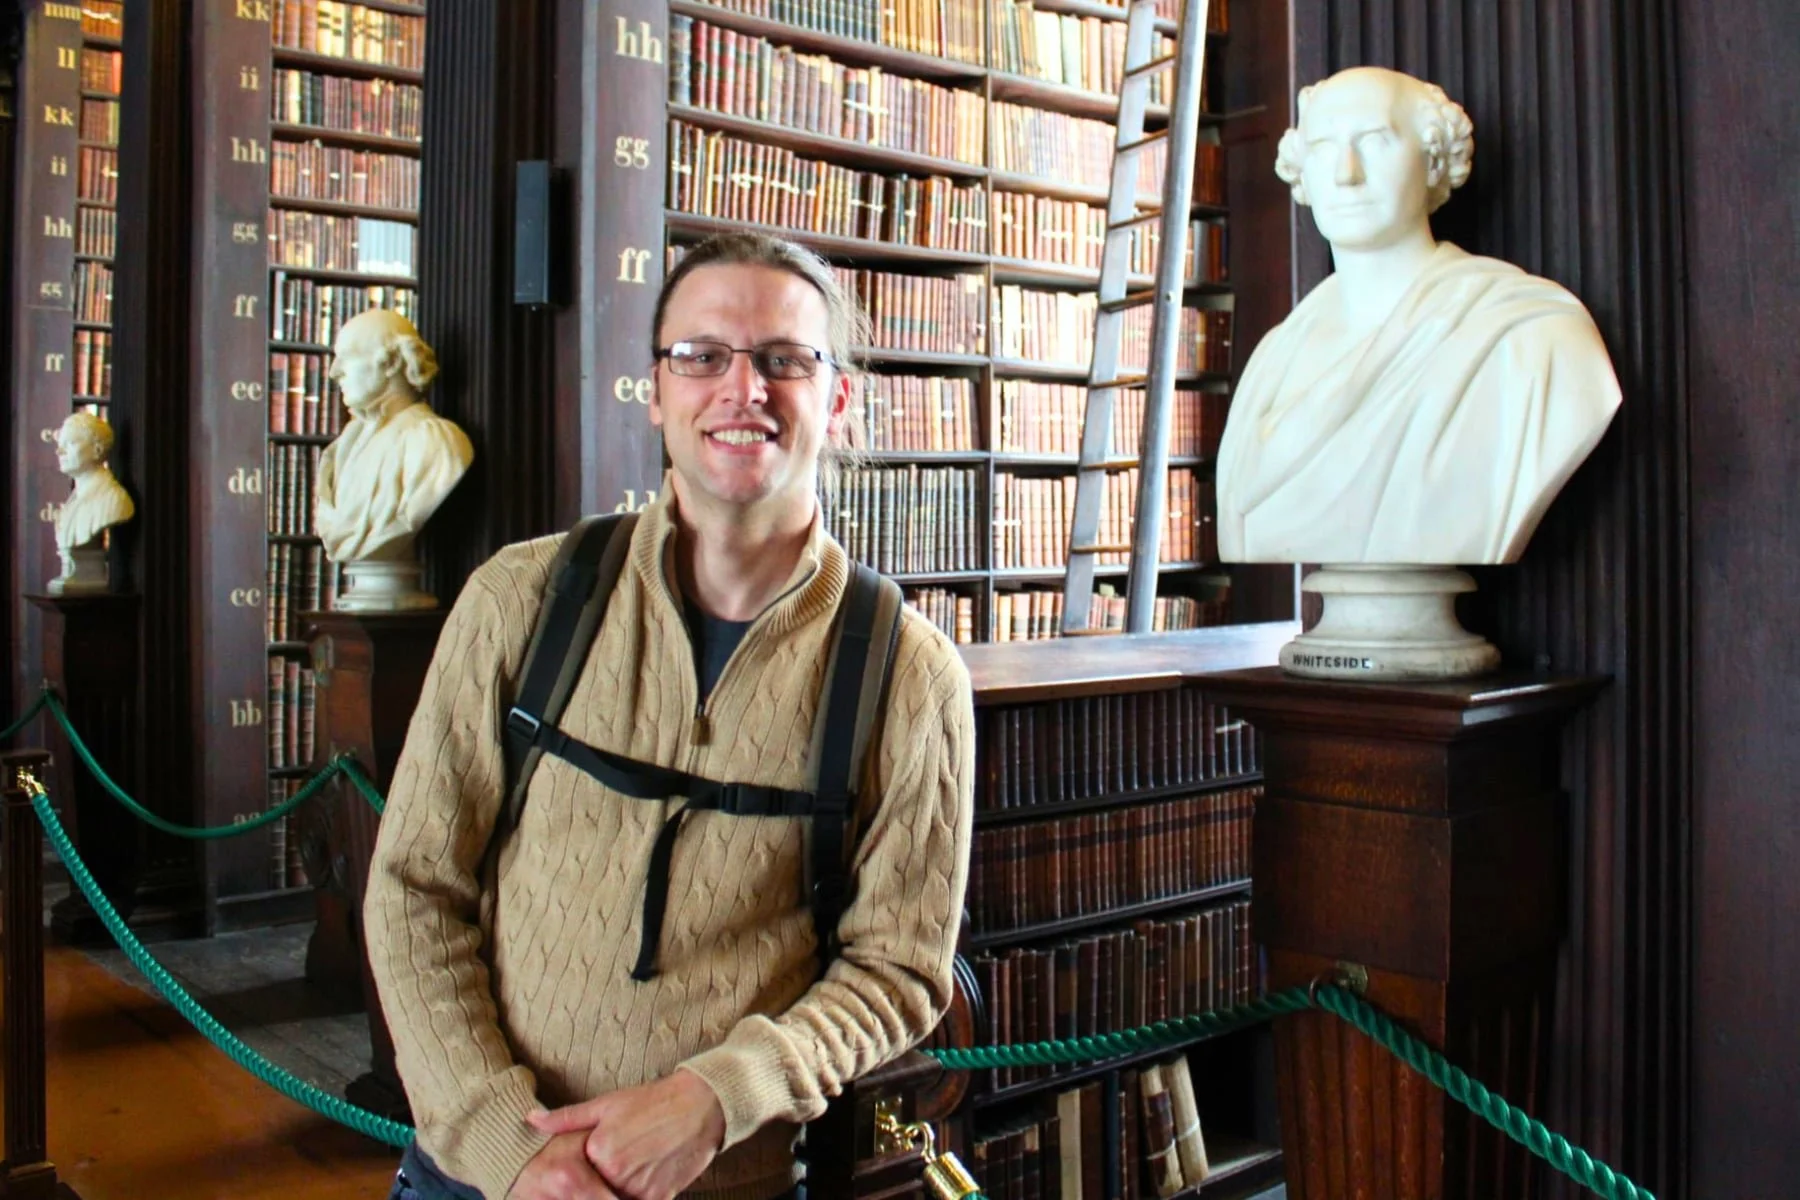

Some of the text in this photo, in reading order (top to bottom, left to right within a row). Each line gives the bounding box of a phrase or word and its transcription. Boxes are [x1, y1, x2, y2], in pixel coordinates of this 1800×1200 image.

[615, 16, 663, 64] hh
[240, 66, 259, 90] ii
[44, 105, 73, 126] kk
[231, 136, 267, 164] hh
[614, 136, 650, 169] gg
[51, 156, 66, 176] ii
[44, 215, 72, 238] hh
[232, 222, 259, 243] gg
[617, 248, 651, 284] ff
[234, 295, 258, 318] ff
[231, 380, 263, 401] ee
[228, 468, 262, 494] dd
[230, 588, 261, 607] cc
[1293, 653, 1370, 669] WHITESIDE
[231, 699, 261, 727] bb
